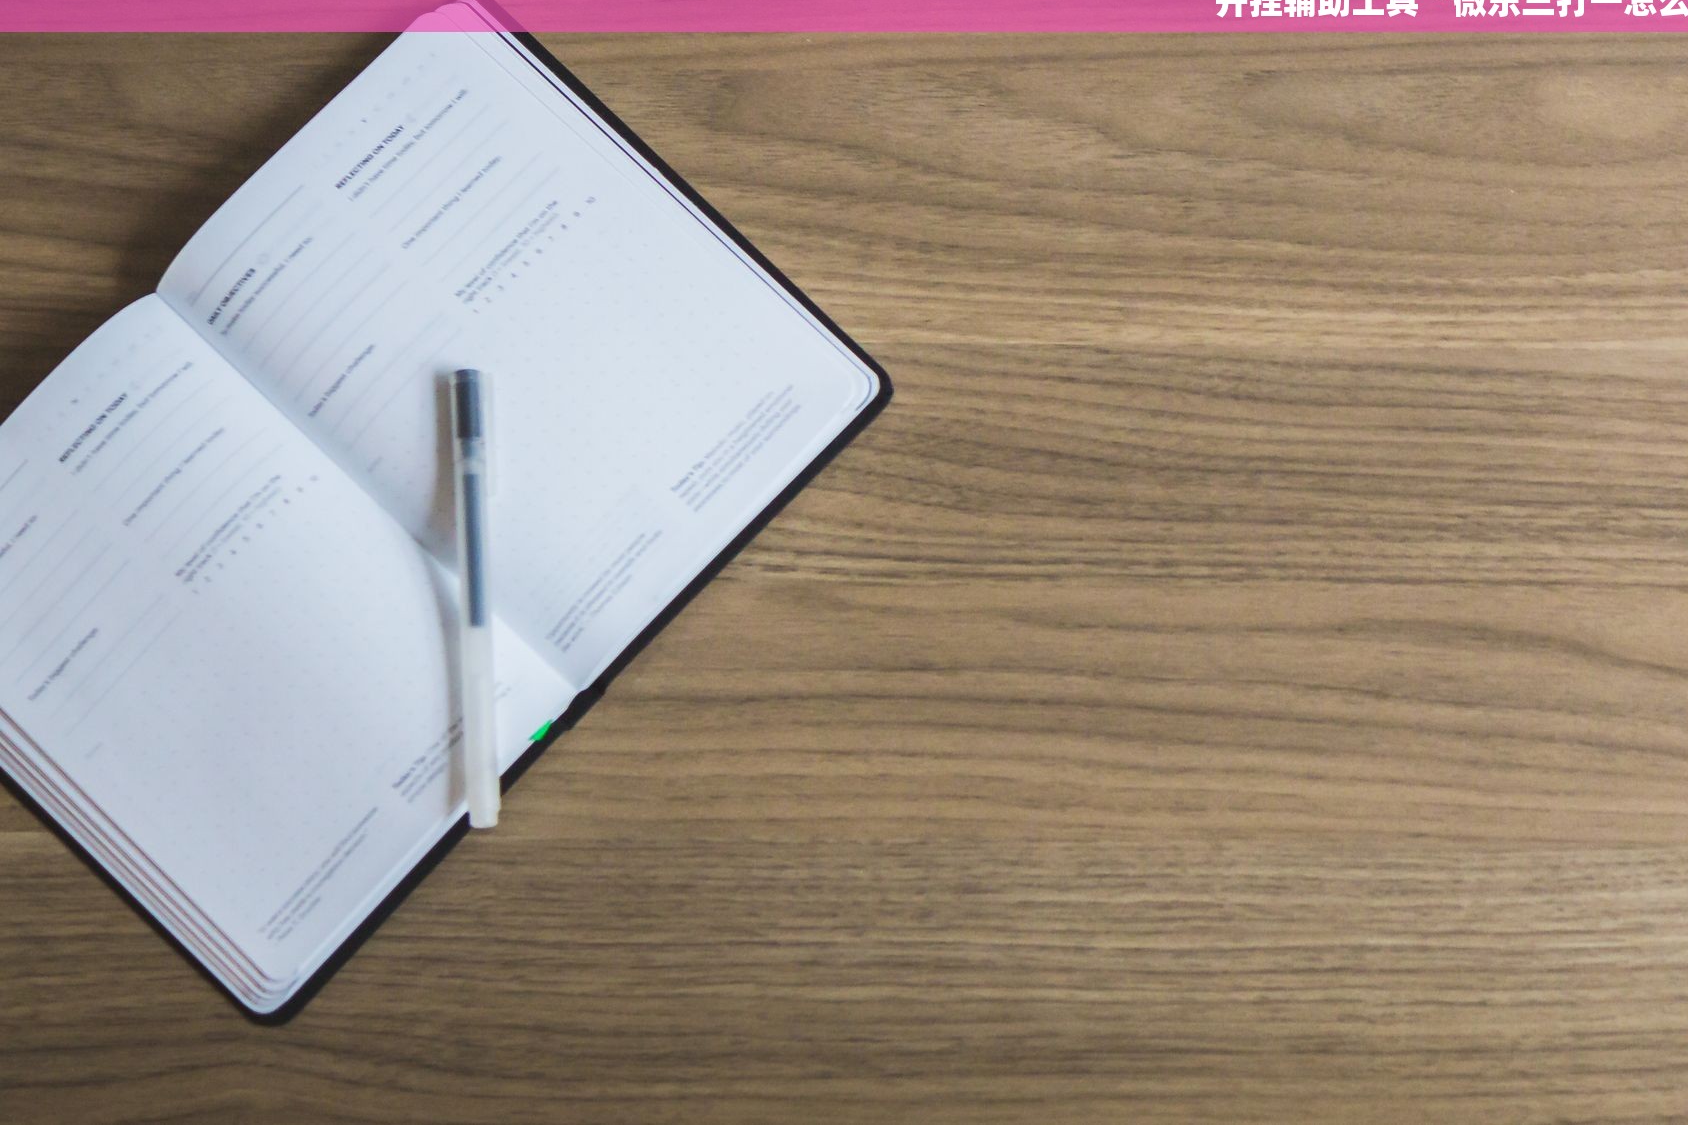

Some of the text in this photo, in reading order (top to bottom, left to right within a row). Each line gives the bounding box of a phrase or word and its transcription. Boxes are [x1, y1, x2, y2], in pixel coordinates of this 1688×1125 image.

[331, 123, 406, 190] REFLECTING ON TODAY
